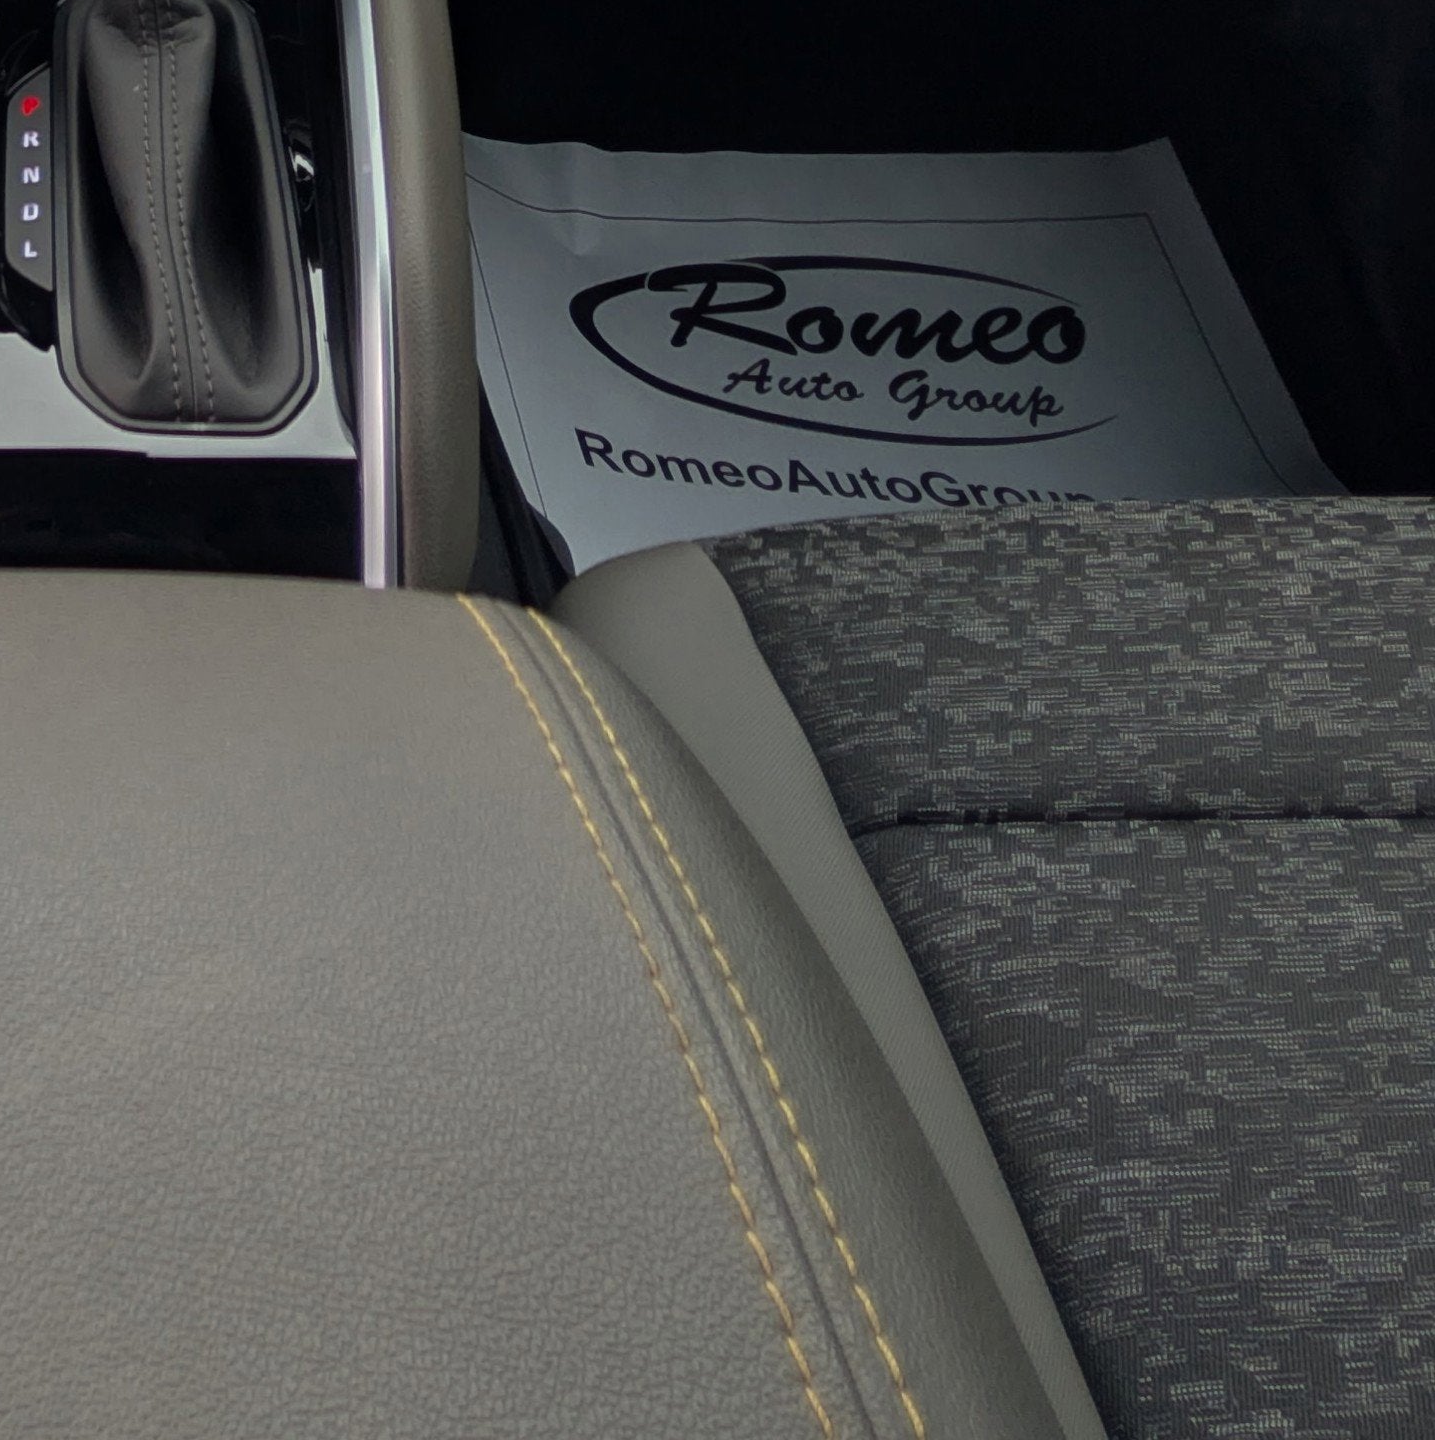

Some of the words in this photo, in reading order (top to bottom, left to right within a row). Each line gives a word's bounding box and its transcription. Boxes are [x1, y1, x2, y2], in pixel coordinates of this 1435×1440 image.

[21, 96, 39, 115] P
[23, 130, 39, 148] R
[22, 165, 40, 184] N
[22, 202, 39, 222] D
[23, 240, 38, 259] L
[645, 263, 1086, 365] Romeo
[723, 357, 864, 404] Auto
[889, 370, 1064, 427] Group
